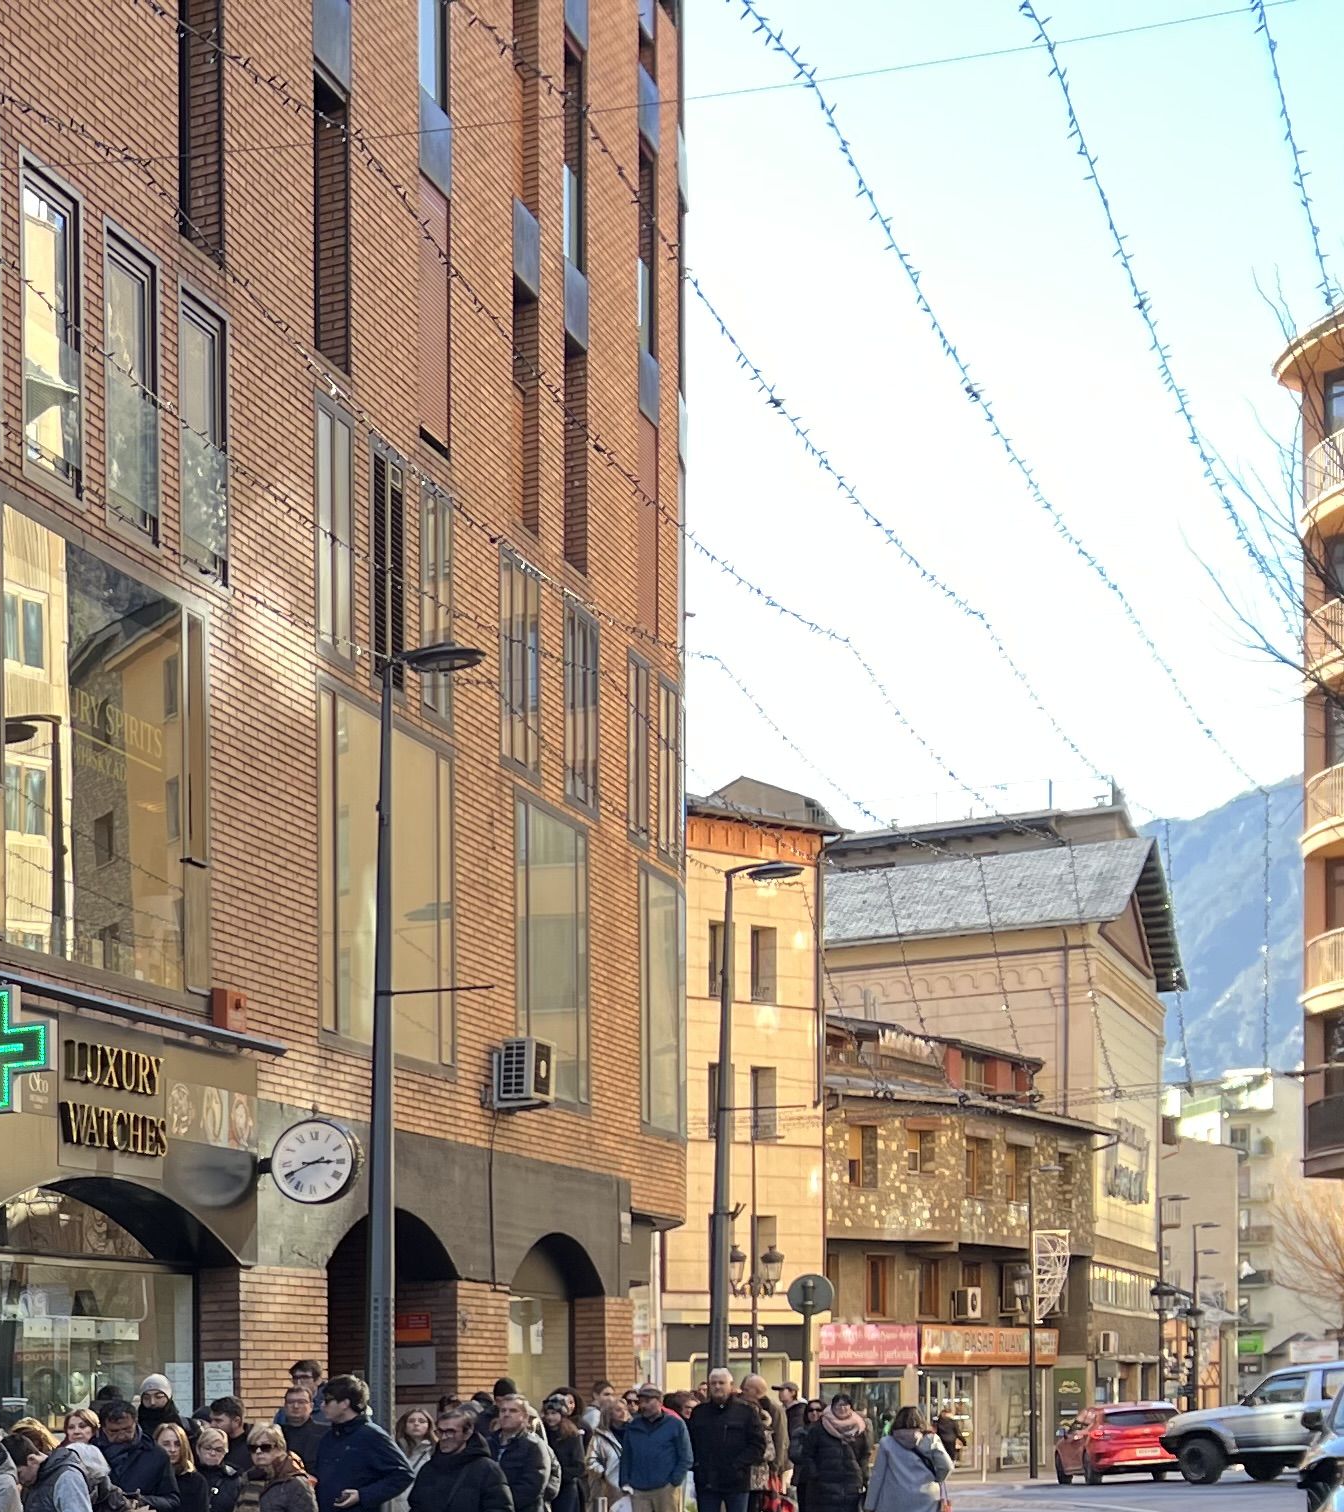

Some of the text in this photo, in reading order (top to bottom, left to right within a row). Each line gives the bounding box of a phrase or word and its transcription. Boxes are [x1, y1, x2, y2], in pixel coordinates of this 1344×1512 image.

[67, 1040, 165, 1096] LUXURY
[63, 1100, 168, 1158] WATCHES
[964, 1331, 995, 1353] BASAR
